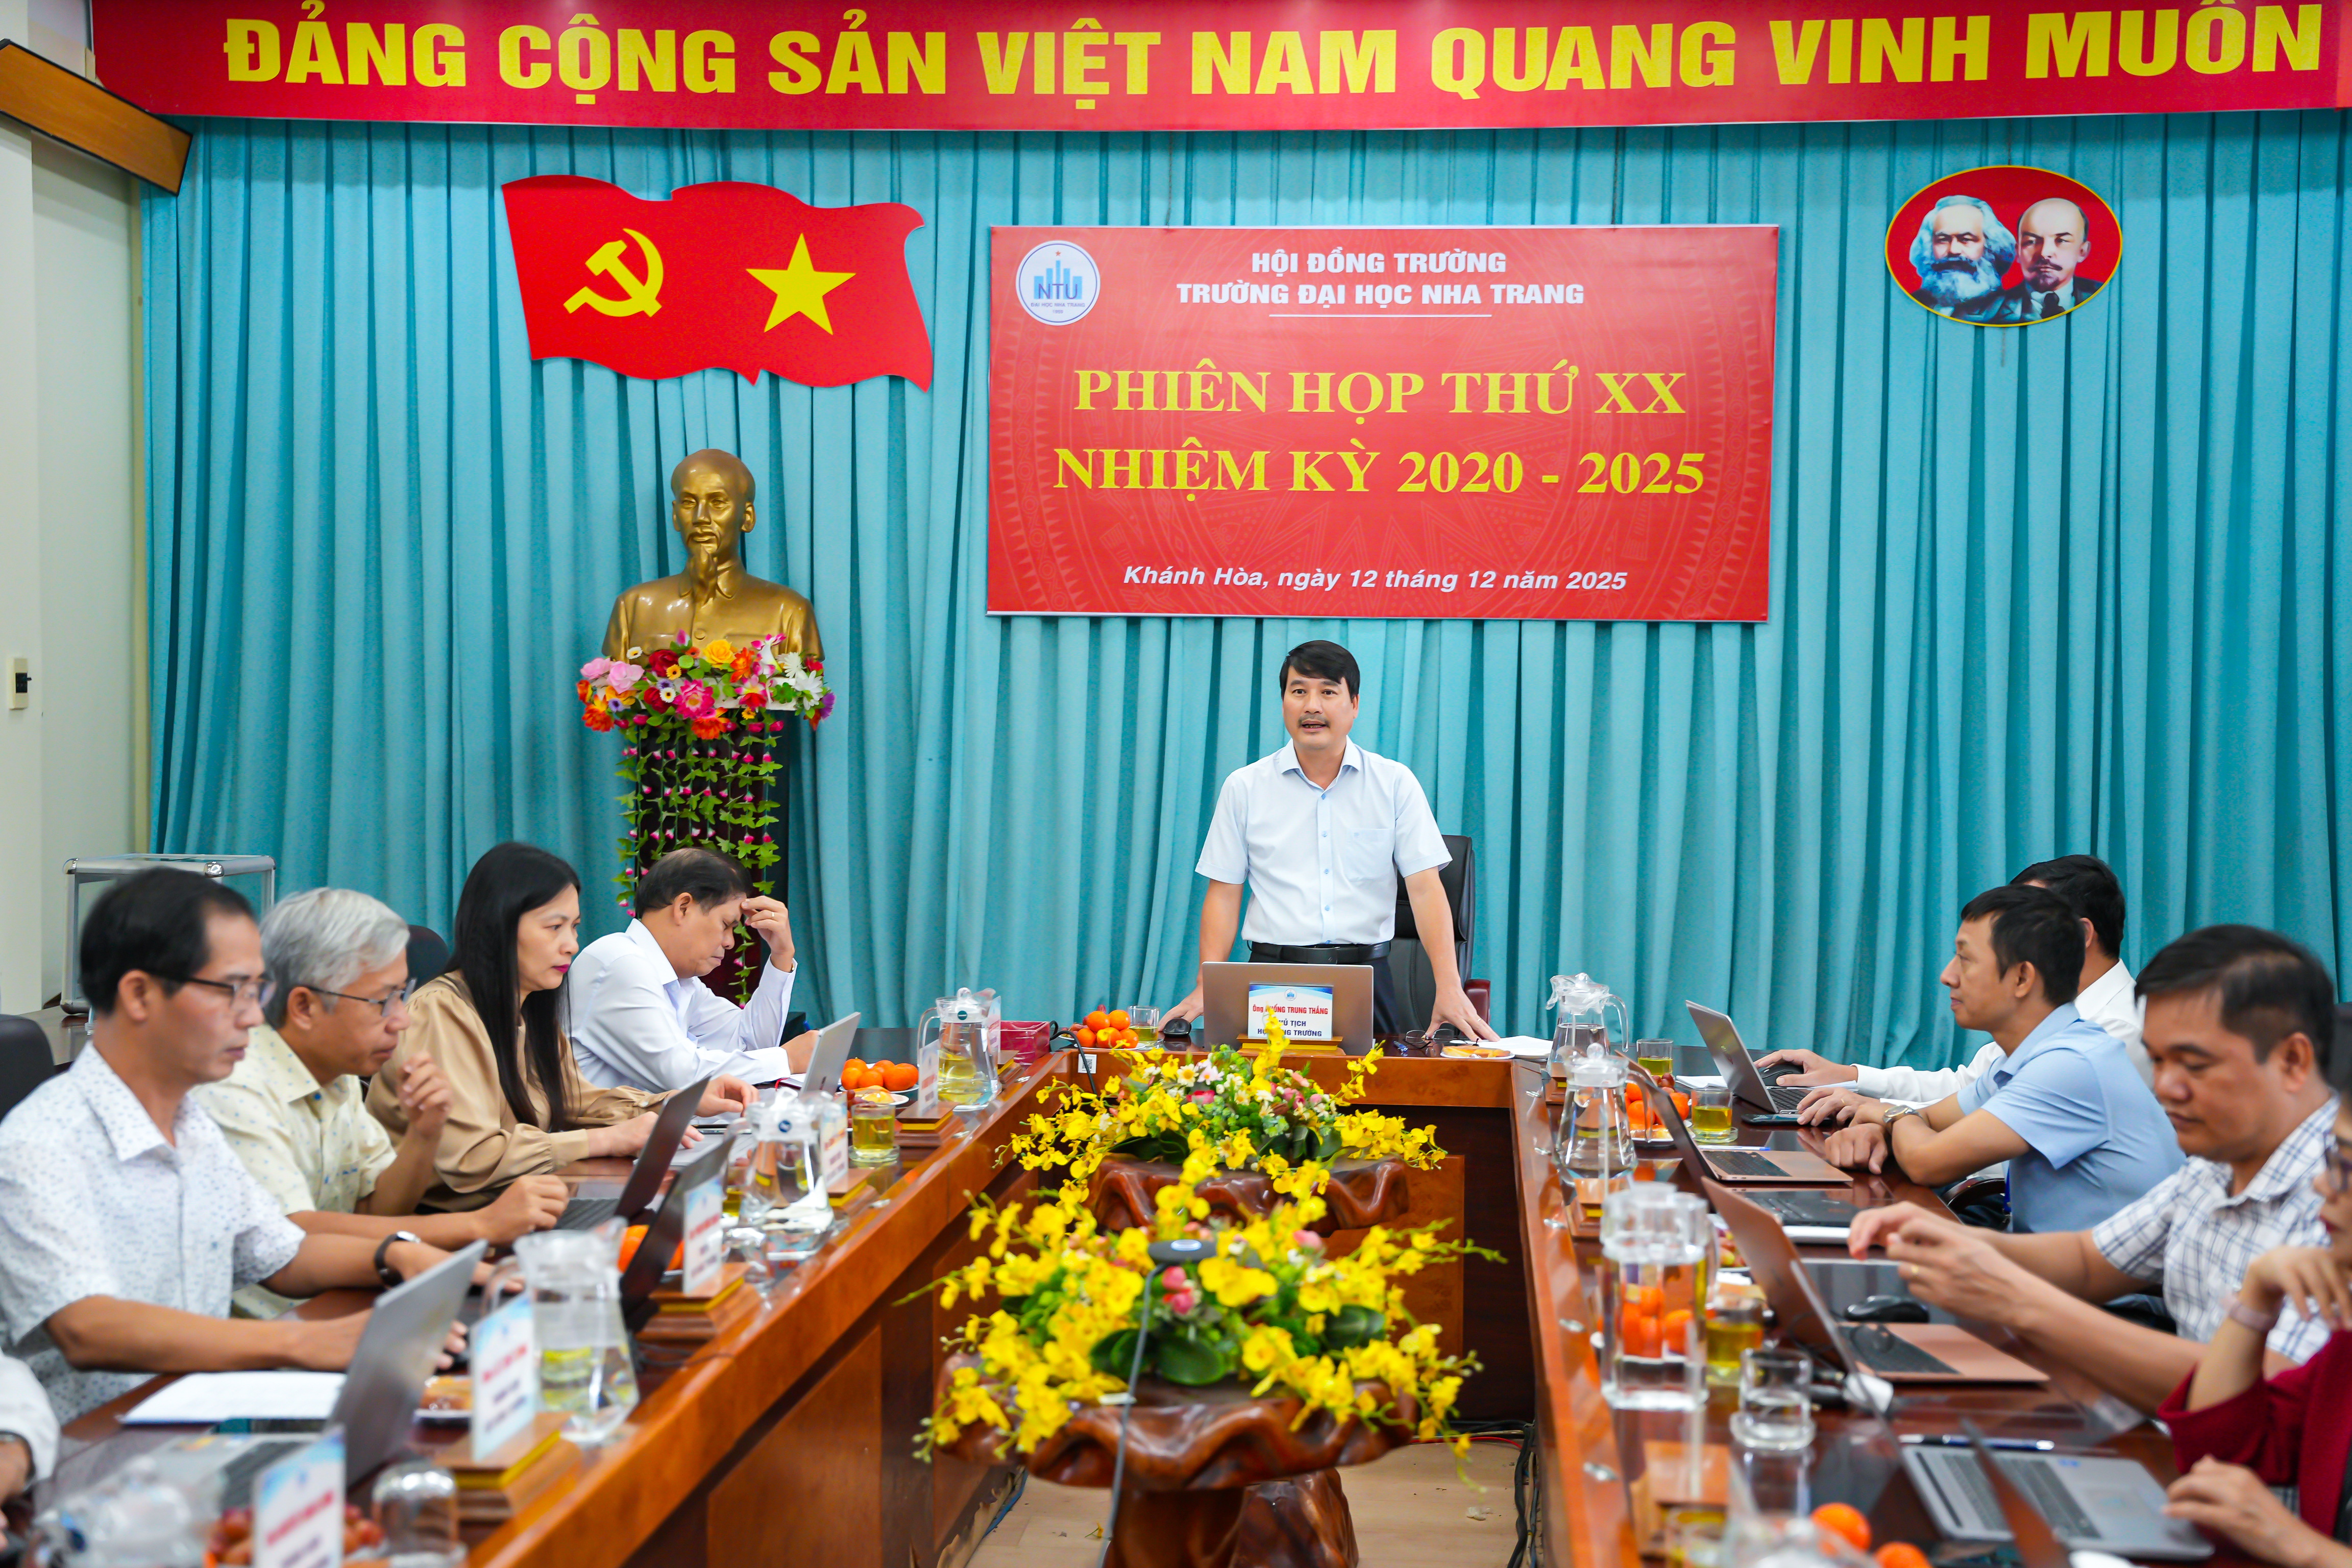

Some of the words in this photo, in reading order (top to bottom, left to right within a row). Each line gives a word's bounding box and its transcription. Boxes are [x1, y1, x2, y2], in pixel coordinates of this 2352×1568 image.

[224, 0, 465, 87] ĐẢNG
[499, 13, 736, 105] CỘNG
[768, 9, 946, 95] SẢN
[976, 18, 1161, 110] VIỆT
[1192, 30, 1397, 94] NAM
[1432, 21, 1736, 100] QUANG
[1770, 15, 1990, 85] VINH
[2025, 0, 2322, 79] MUÔN
[1252, 249, 1298, 277] HỘI
[1307, 247, 1385, 273] ĐỒNG
[1393, 248, 1506, 273] TRƯỜNG
[1038, 283, 1078, 300] NTU
[1176, 280, 1289, 304] TRƯỜNG
[1297, 284, 1346, 309] ĐẠI
[1355, 284, 1412, 309] HỌC
[1422, 284, 1482, 304] NHA
[1490, 284, 1584, 305] TRANG
[1074, 358, 1270, 413] PHIÊN
[1289, 372, 1425, 425] HỌP
[1442, 358, 1580, 414] THỨ
[1595, 373, 1686, 414] XX
[1053, 436, 1271, 502] NHIỆM
[1288, 438, 1381, 492] KỲ
[1397, 451, 1524, 493] 2020
[1542, 475, 1559, 483] -
[1578, 452, 1705, 494] 2025
[1123, 566, 1205, 584] Khánh
[1213, 567, 1268, 589] Hòa,
[1278, 568, 1341, 591] ngày
[1351, 570, 1378, 587] 12
[1385, 569, 1458, 593] tháng
[1468, 571, 1496, 588] 12
[1503, 571, 1558, 589] năm
[1565, 572, 1628, 590] 2025
[1253, 1004, 1264, 1013] Ông
